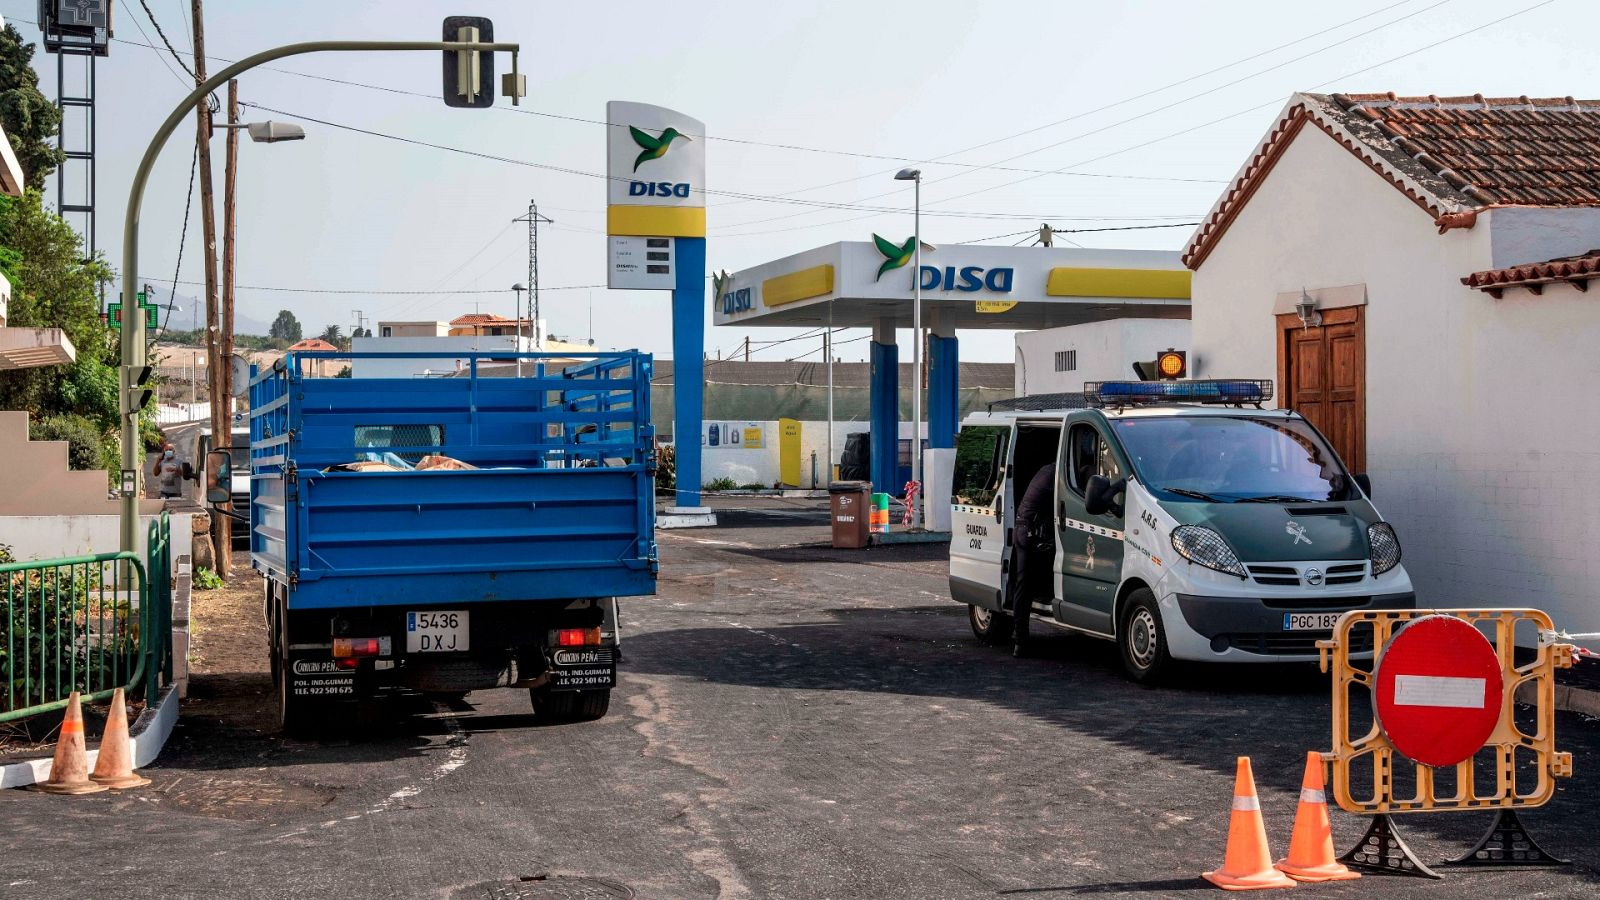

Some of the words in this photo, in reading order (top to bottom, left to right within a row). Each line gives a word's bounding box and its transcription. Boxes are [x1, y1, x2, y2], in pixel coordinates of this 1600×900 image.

[629, 181, 691, 198] DISA
[911, 265, 1014, 292] DISA
[1141, 509, 1158, 531] A.R.S.
[966, 524, 988, 537] GUARDIA
[969, 538, 983, 550] CIVIL
[420, 613, 459, 629] 5436
[1290, 615, 1314, 629] PGC
[1317, 614, 1342, 628] 183
